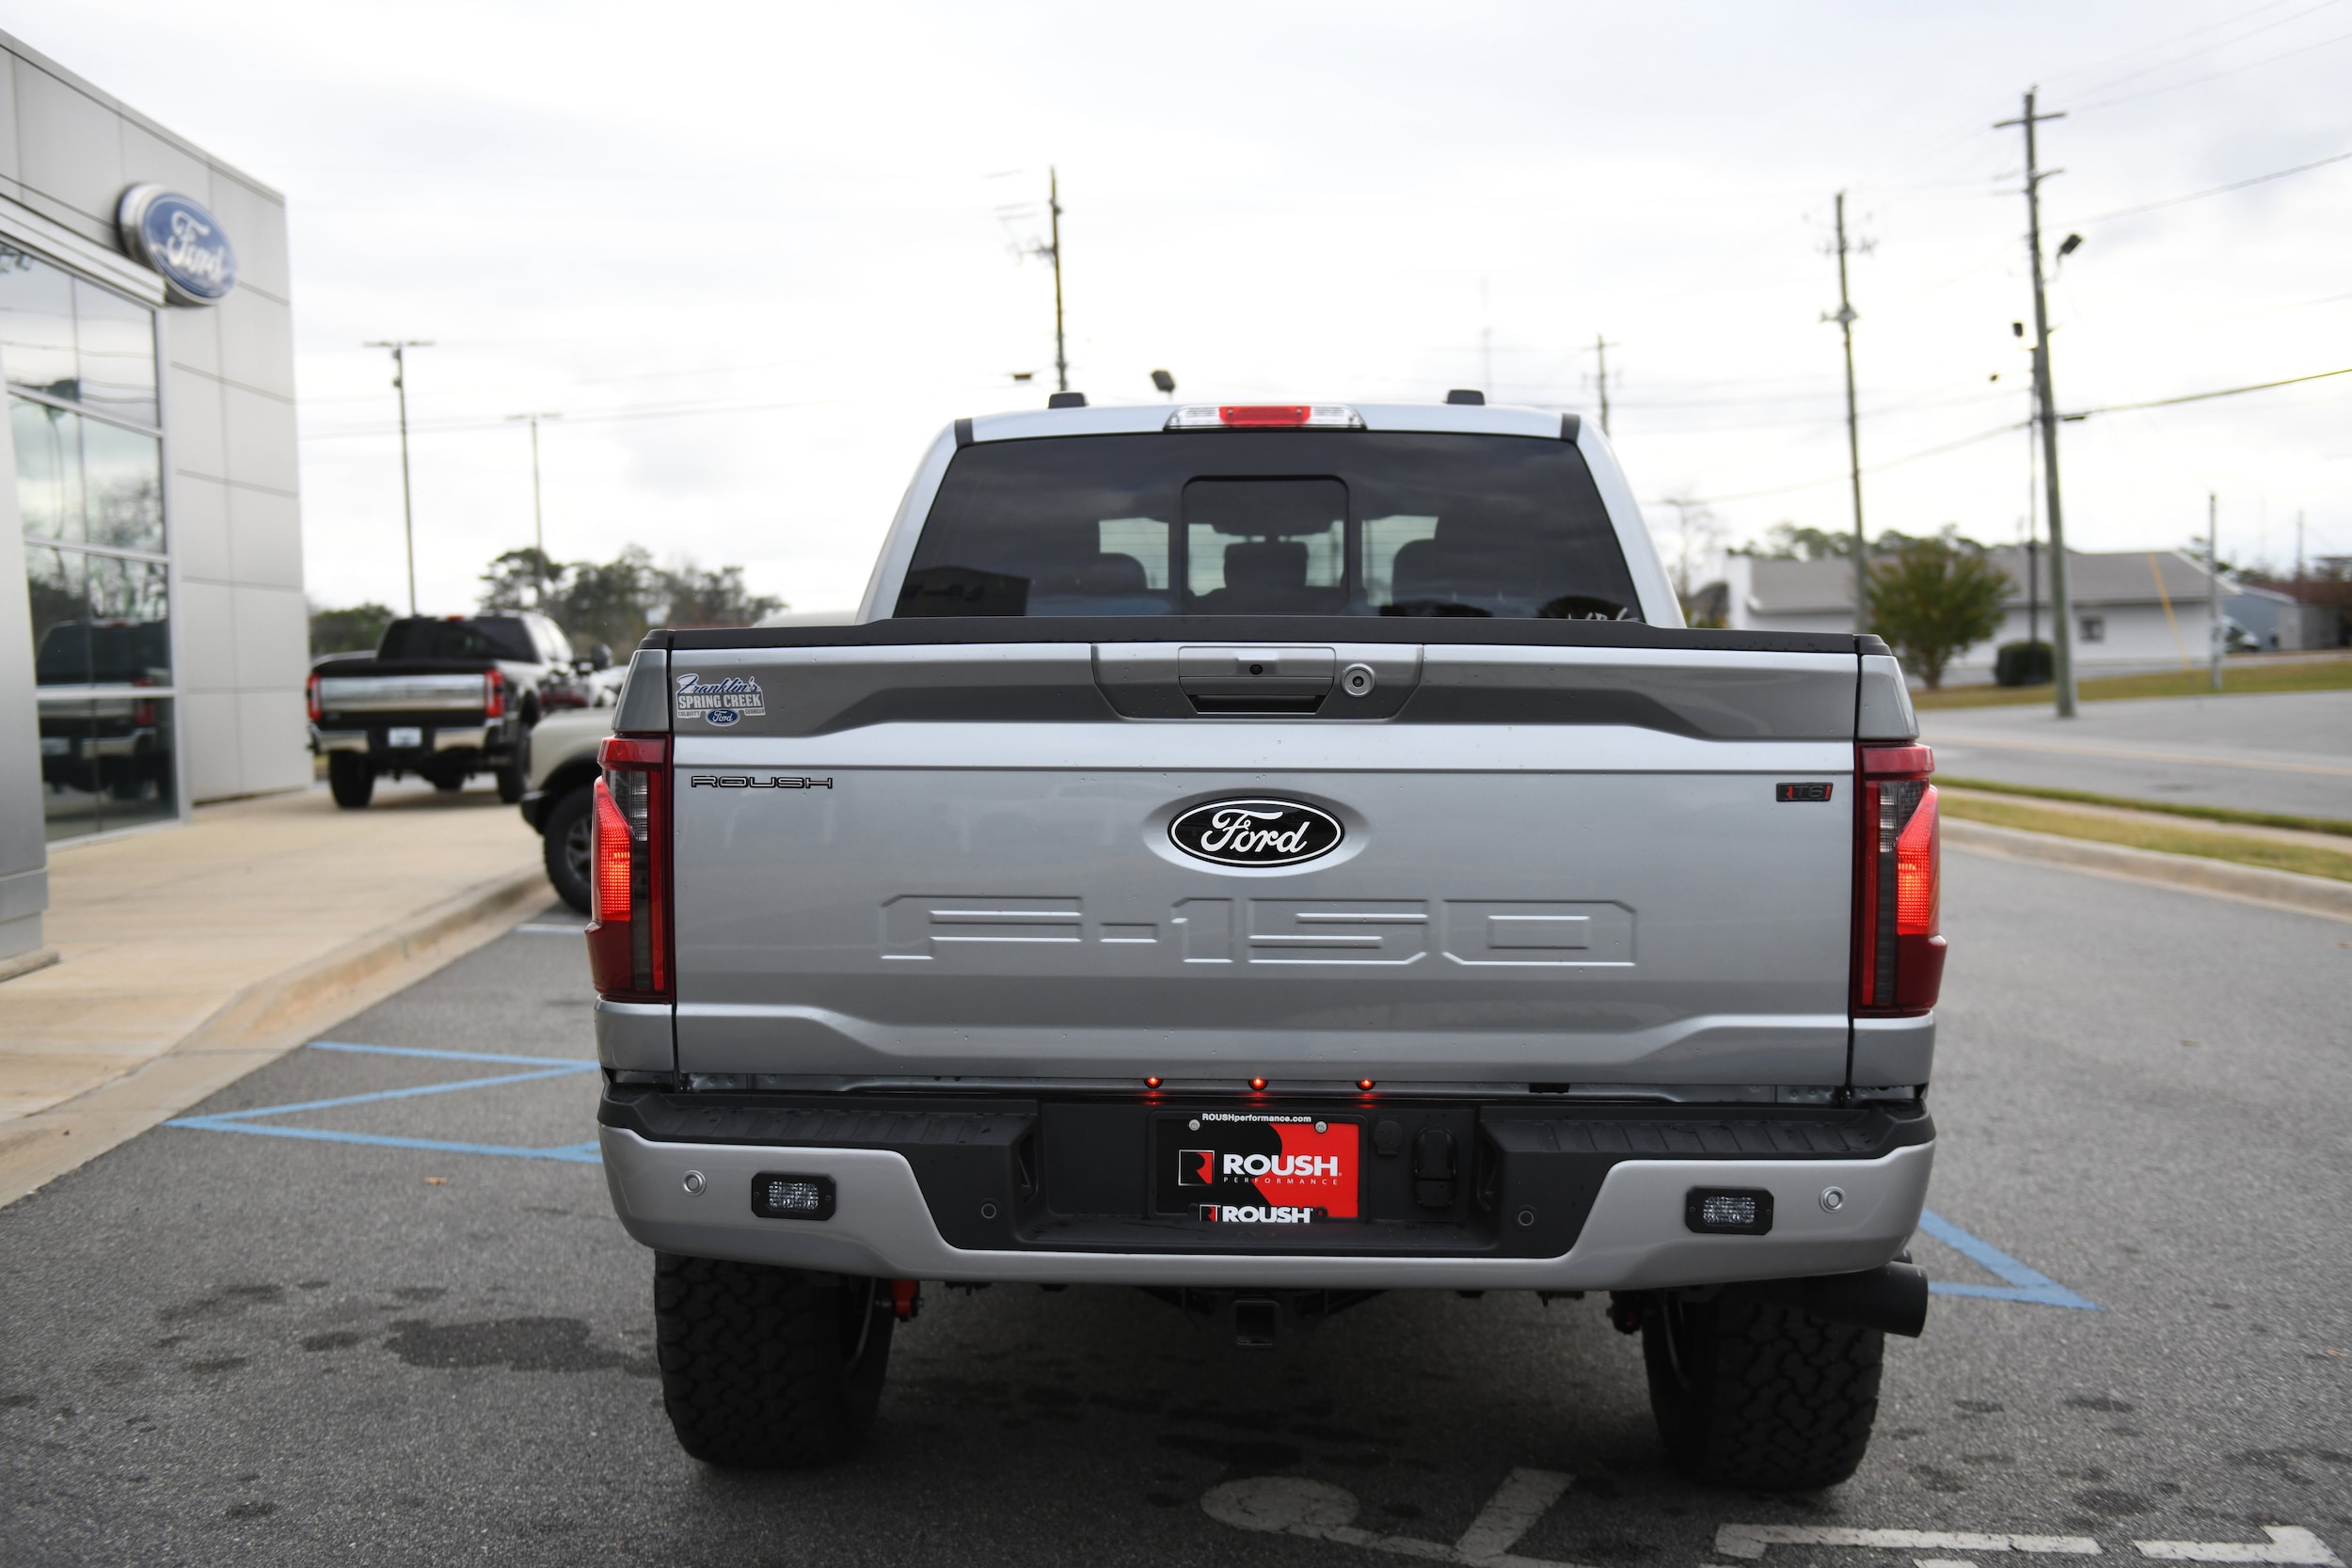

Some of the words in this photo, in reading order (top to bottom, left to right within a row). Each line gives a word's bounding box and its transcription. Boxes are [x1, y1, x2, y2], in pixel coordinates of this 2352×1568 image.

[167, 209, 227, 284] Ford
[677, 674, 759, 694] Franklin's
[678, 694, 722, 709] SPRING
[723, 692, 762, 707] CREEK
[712, 710, 733, 722] Ford
[691, 775, 834, 789] ROUSH
[1200, 807, 1308, 854] Ford
[881, 895, 1636, 966] F-150
[1201, 1113, 1311, 1123] ROUSHperformance.com
[1223, 1153, 1338, 1176] ROUSH
[1223, 1177, 1338, 1185] PERFORMANCE
[1222, 1206, 1311, 1223] ROUSH
